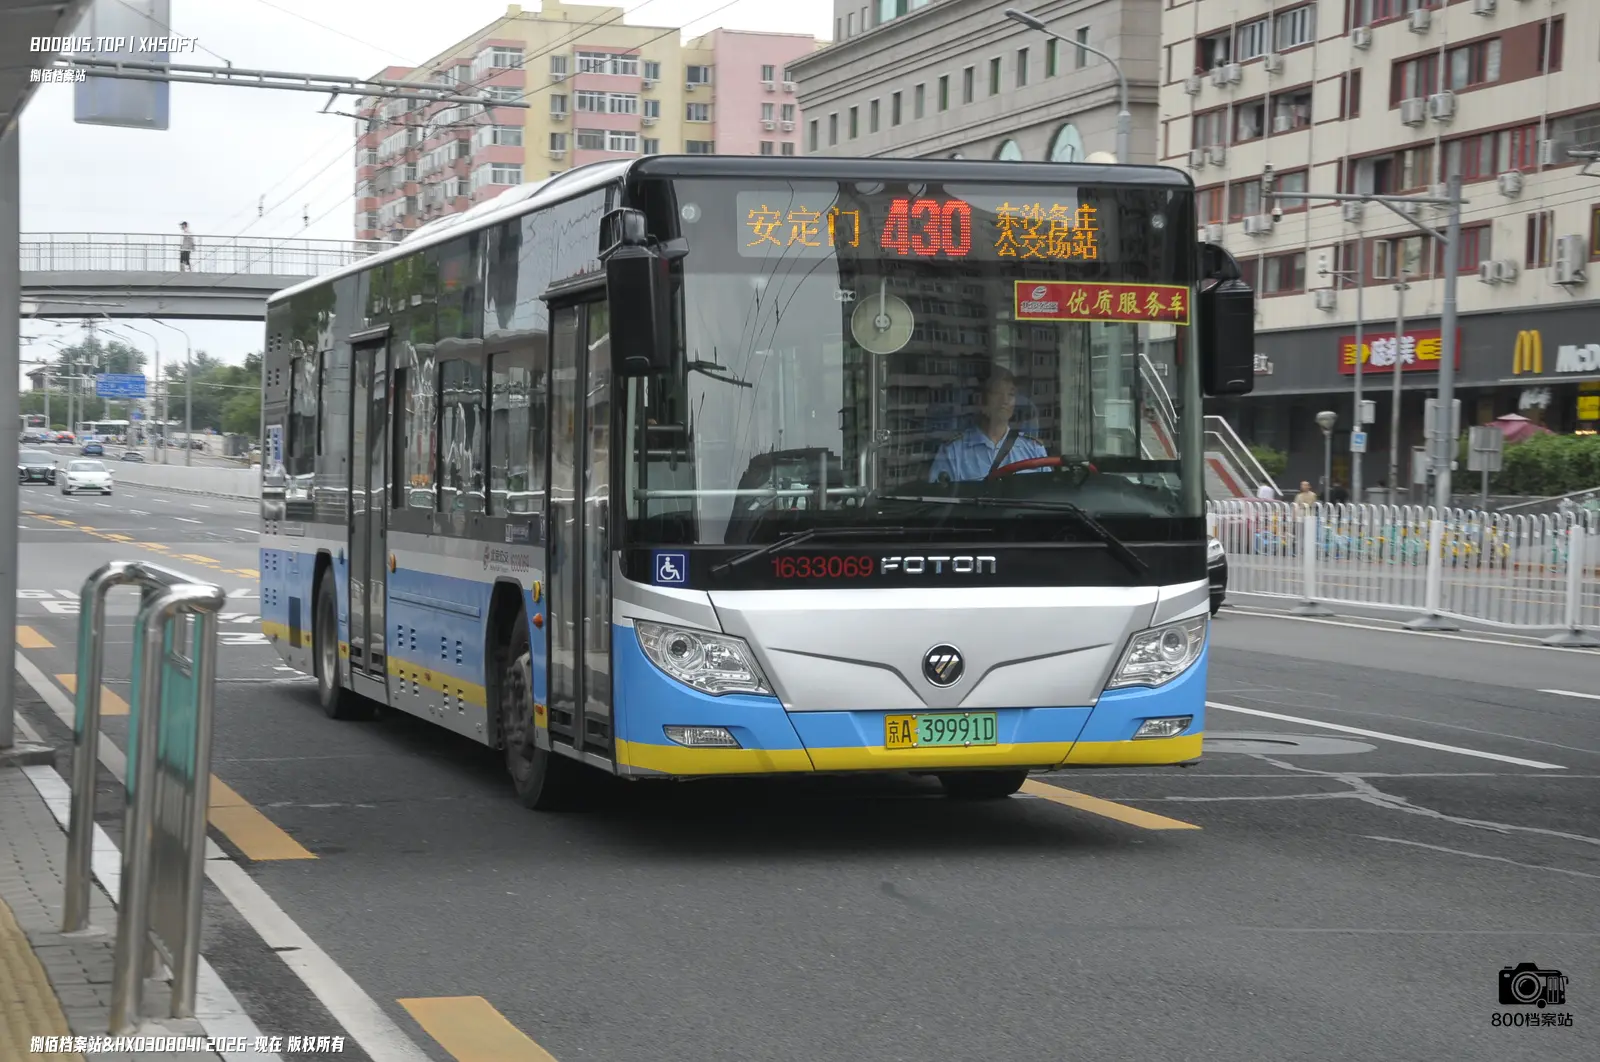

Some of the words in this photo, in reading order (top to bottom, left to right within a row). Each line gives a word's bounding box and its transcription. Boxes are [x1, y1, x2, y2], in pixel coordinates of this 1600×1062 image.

[747, 205, 860, 247] 安定门
[881, 199, 972, 256] 430
[995, 229, 1098, 260] 公交场站
[1066, 288, 1184, 319] 优质服务车
[771, 556, 873, 578] 1633069
[881, 556, 996, 575] FOTON
[922, 717, 994, 742] 39991D
